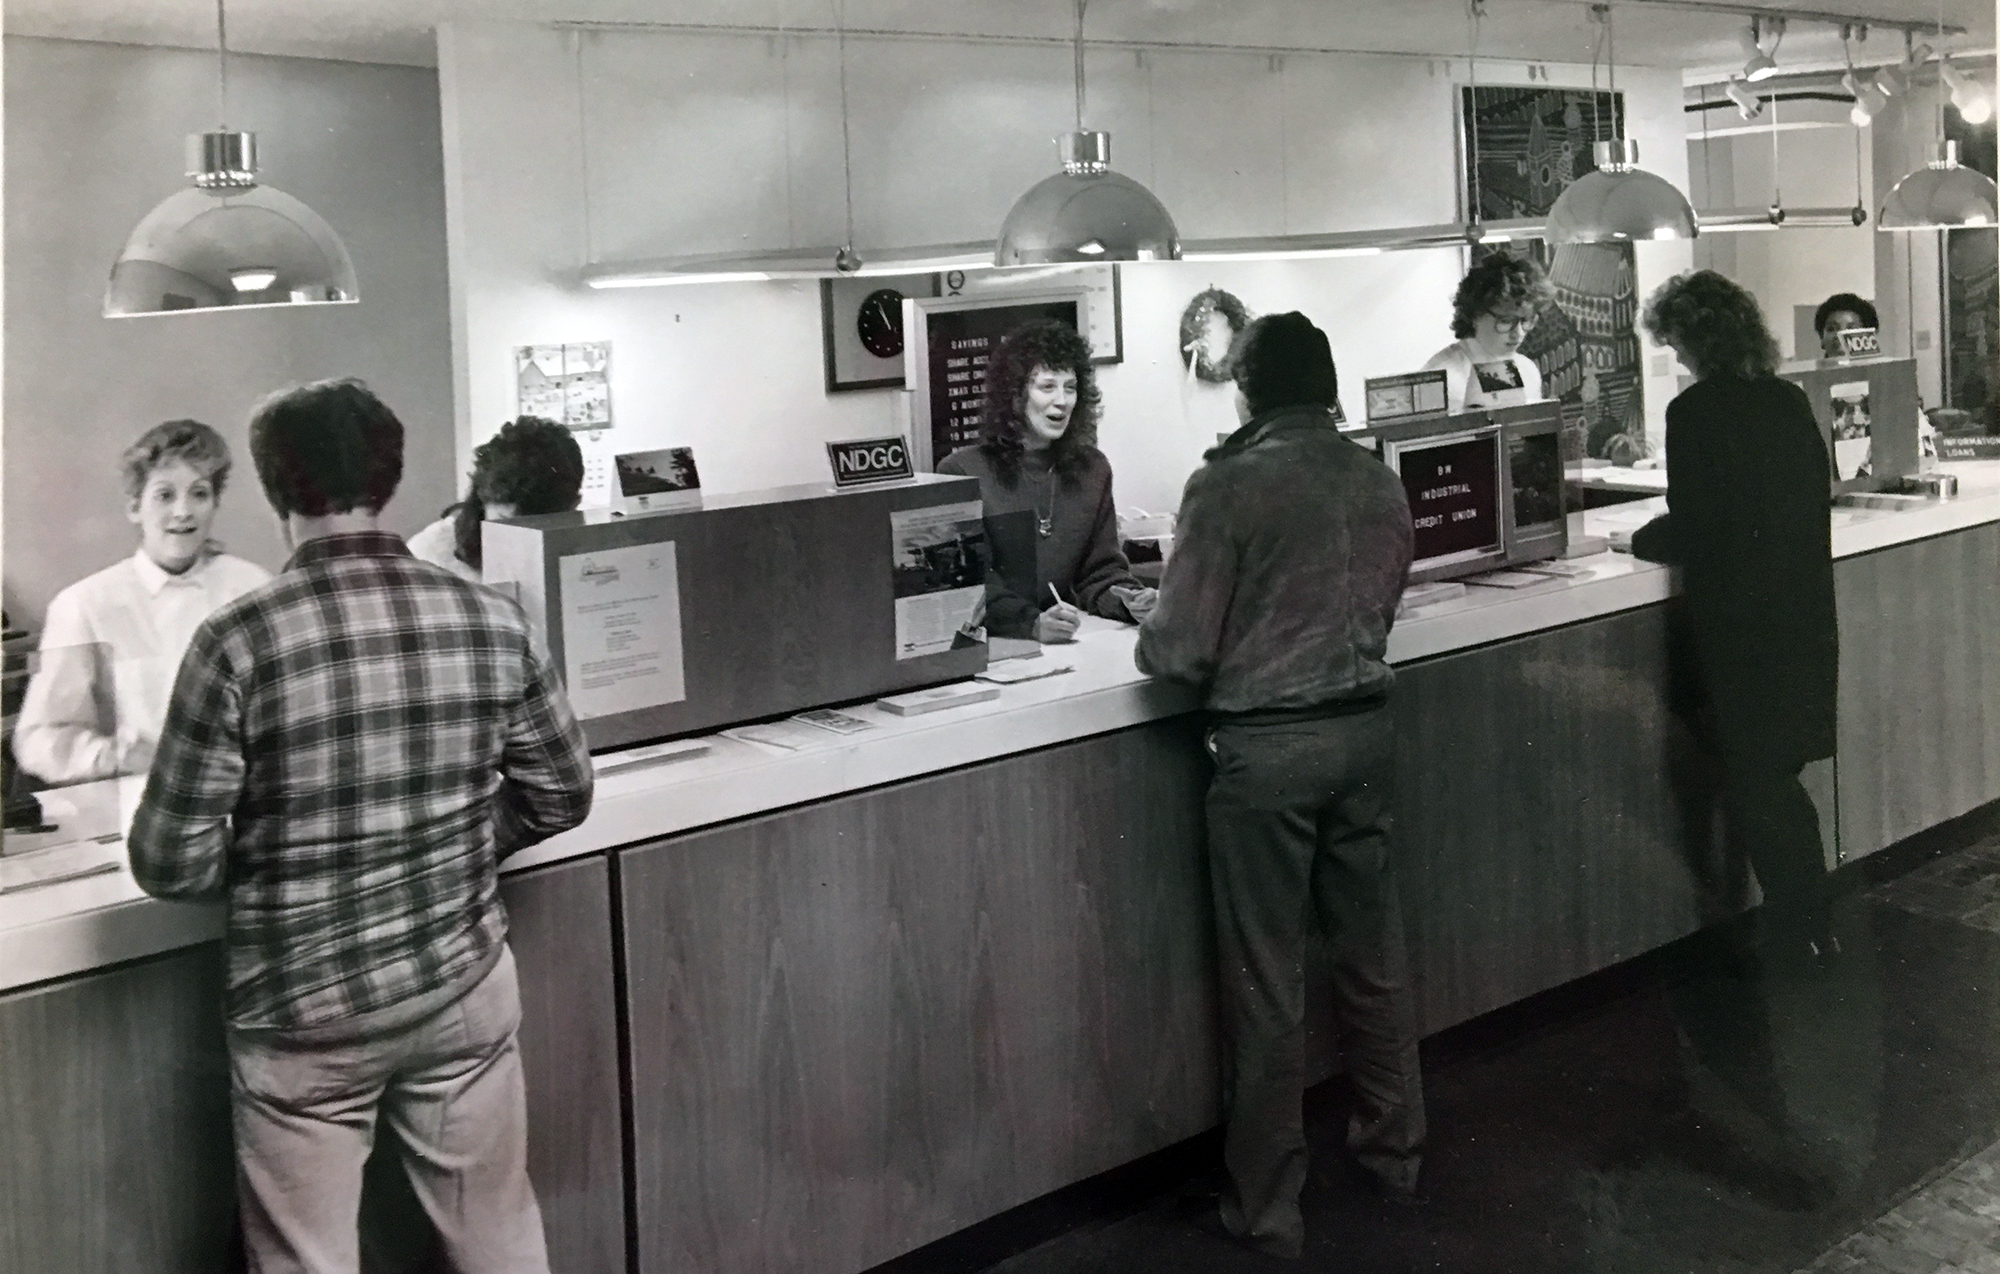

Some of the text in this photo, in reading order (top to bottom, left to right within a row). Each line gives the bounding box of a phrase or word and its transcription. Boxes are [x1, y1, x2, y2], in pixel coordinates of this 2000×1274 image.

[951, 338, 989, 350] SAVINGS
[1847, 335, 1878, 351] NDGC
[948, 386, 969, 397] XMAS
[951, 401, 958, 411] 6
[963, 430, 980, 440] MON
[1943, 436, 2000, 446] INFORMATION
[1946, 447, 1976, 457] LOANS
[838, 445, 904, 473] NDGC
[1421, 483, 1471, 500] INDUSTRIAL
[1414, 508, 1477, 529] CREDIT UNION
